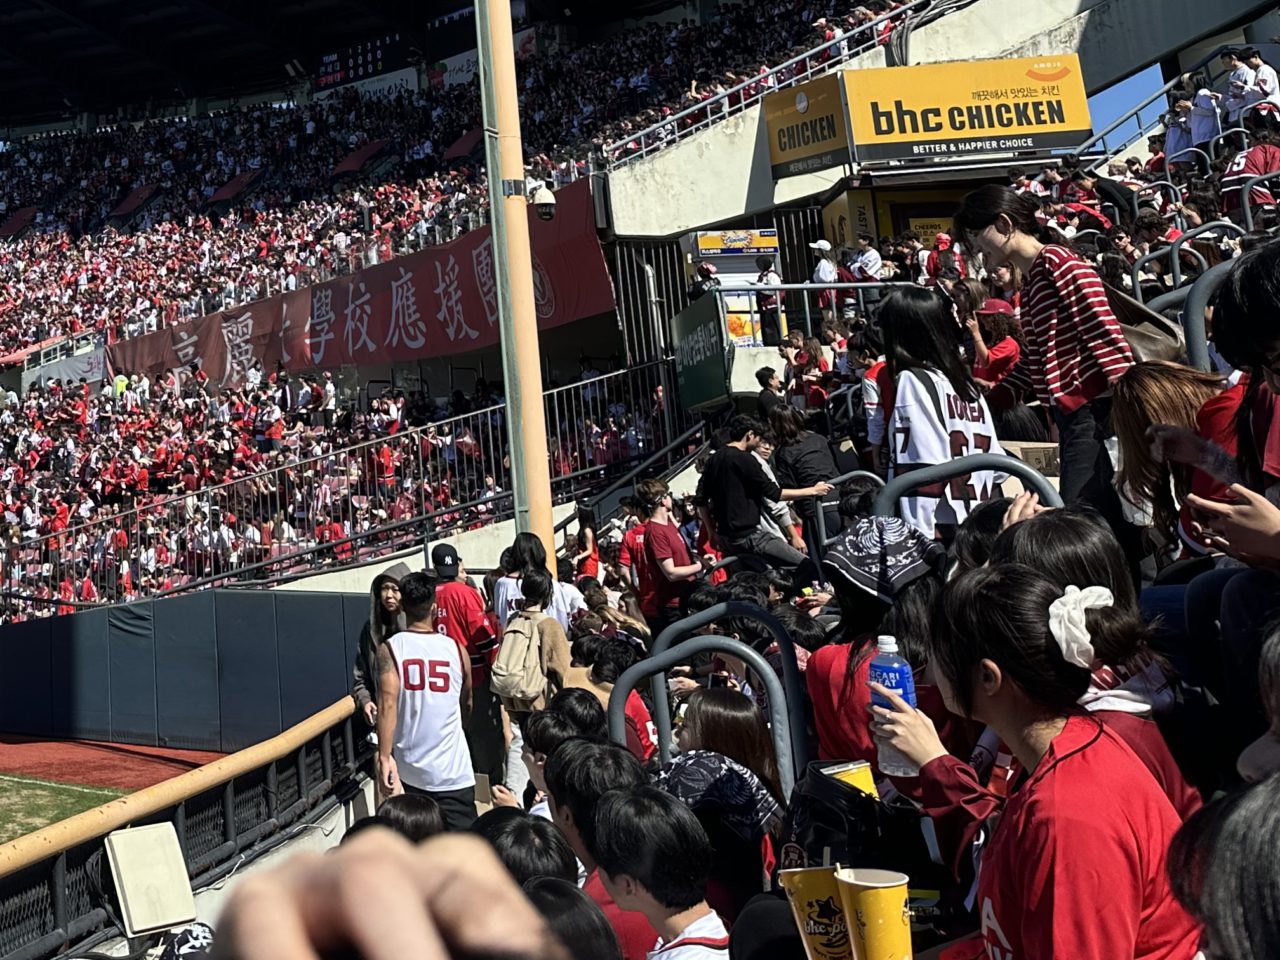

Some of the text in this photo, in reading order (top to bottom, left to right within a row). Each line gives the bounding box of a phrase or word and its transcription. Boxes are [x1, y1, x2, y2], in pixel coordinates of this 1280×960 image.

[971, 84, 1060, 101] 깨끗해서 맛있는 치킨
[870, 99, 1066, 136] bhc CHICKEN
[777, 114, 836, 152] CHICKEN
[913, 137, 1033, 154] BETTER & HAPPIER CHOICE
[857, 205, 868, 229] TAST
[402, 658, 451, 693] 05
[870, 671, 901, 681] OCARI
